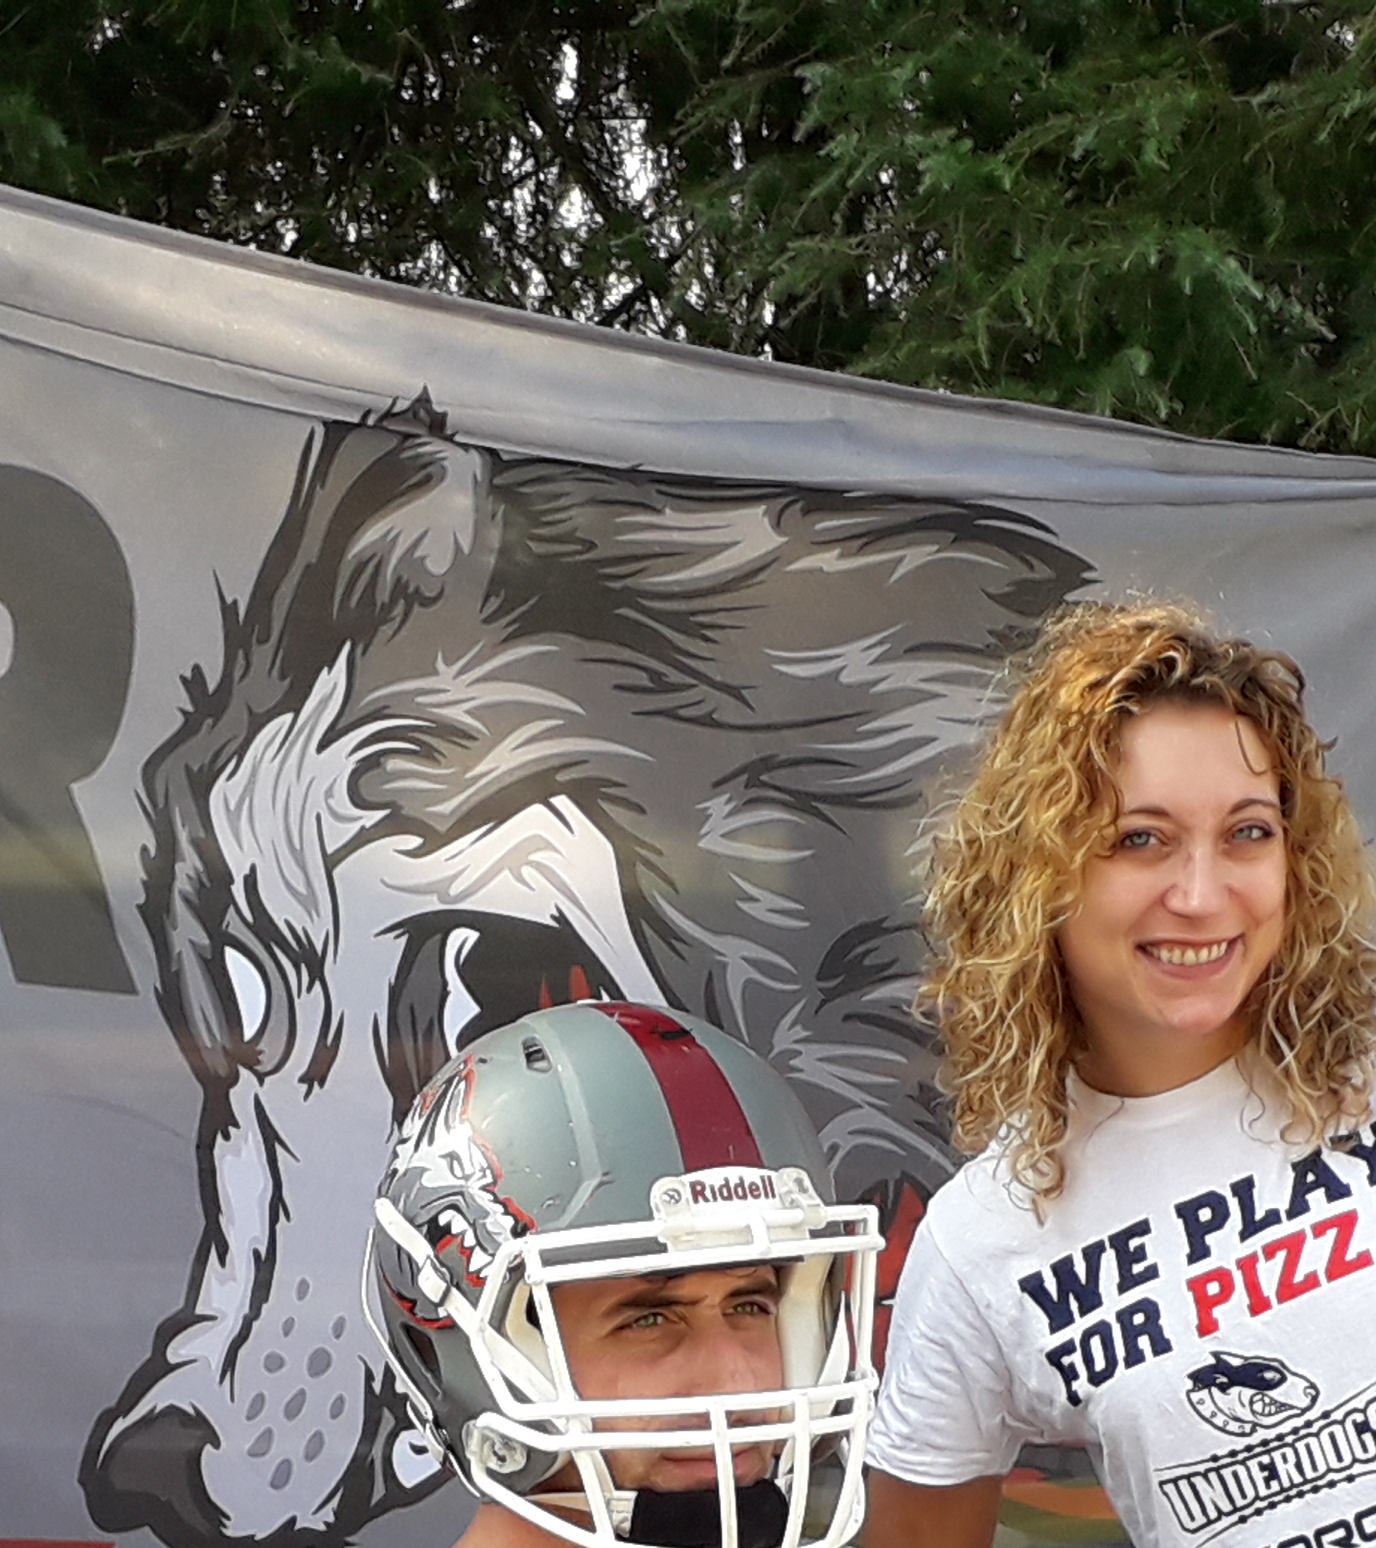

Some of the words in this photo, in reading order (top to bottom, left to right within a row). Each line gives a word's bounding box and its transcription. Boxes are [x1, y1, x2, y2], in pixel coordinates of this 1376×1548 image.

[689, 1175, 777, 1205] Riddell
[1018, 1218, 1159, 1335] WE
[1045, 1297, 1173, 1407] FOR
